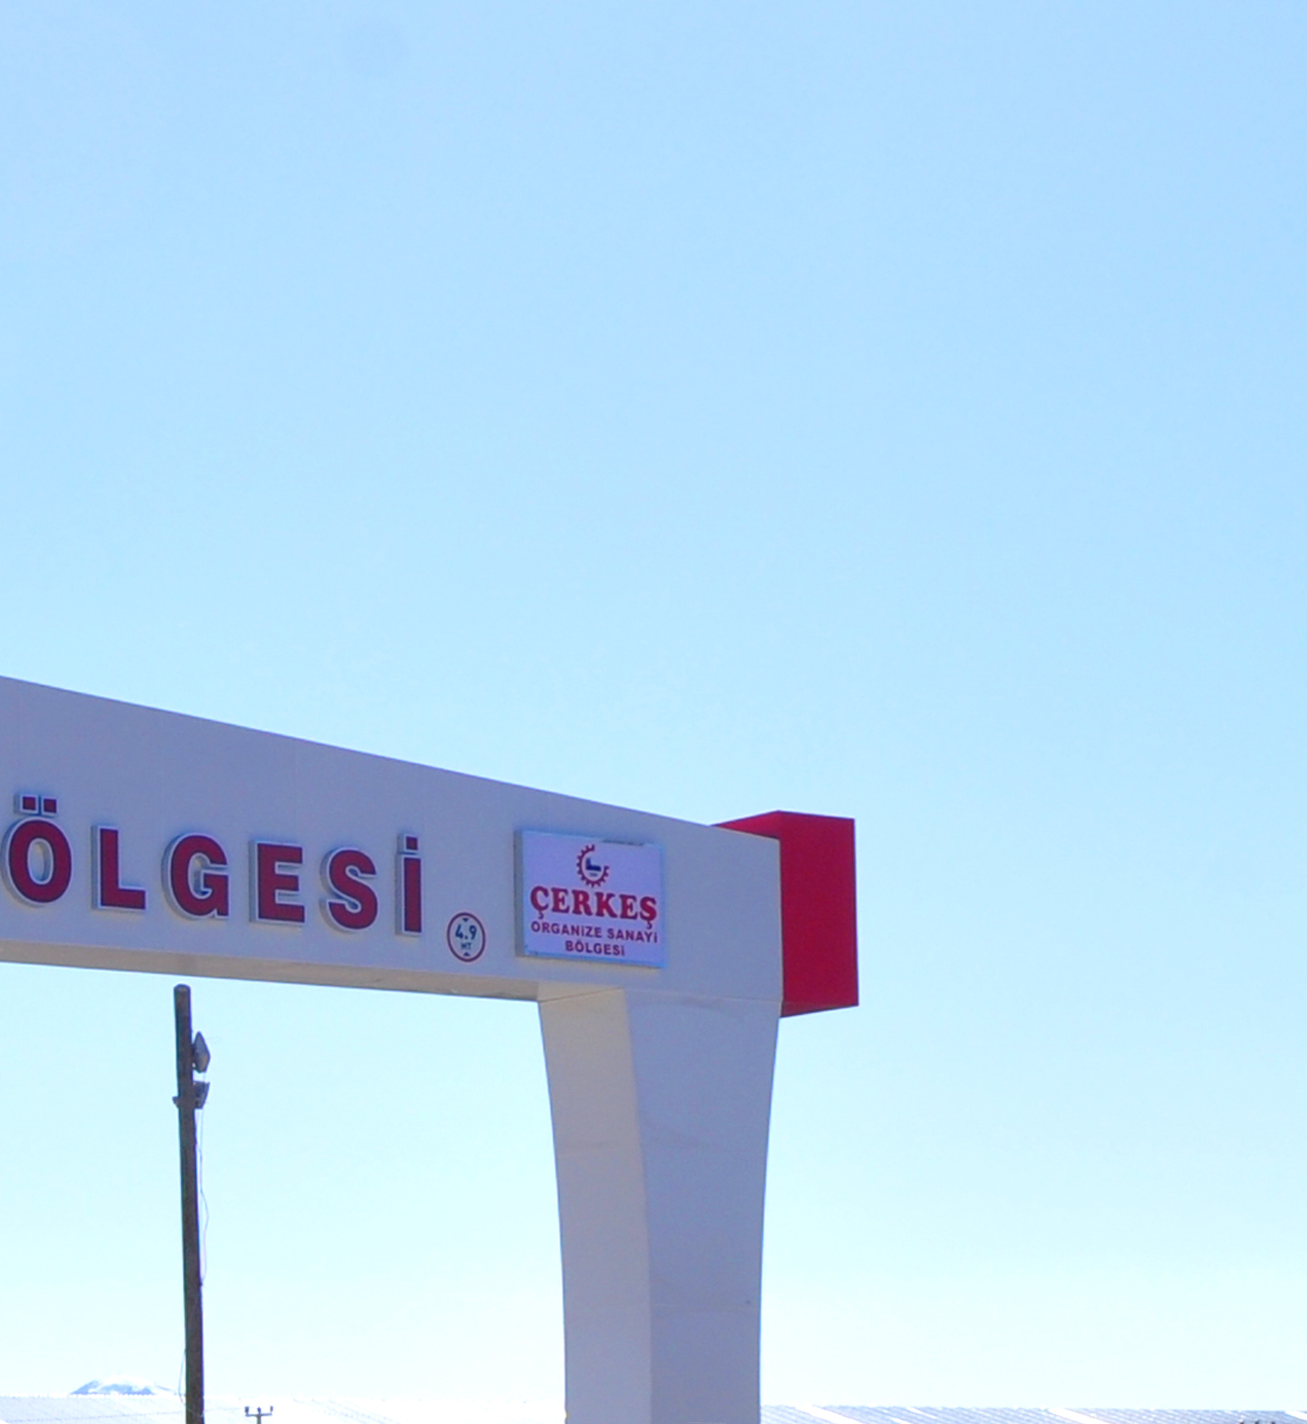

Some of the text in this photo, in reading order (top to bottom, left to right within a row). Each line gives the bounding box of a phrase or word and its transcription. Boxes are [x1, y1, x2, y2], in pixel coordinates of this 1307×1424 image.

[530, 886, 657, 930] ÇERKEŞ
[455, 923, 478, 940] 4.9
[531, 921, 658, 943] ORGANİZE SANAYİ
[565, 939, 625, 956] BÖLGESİ
